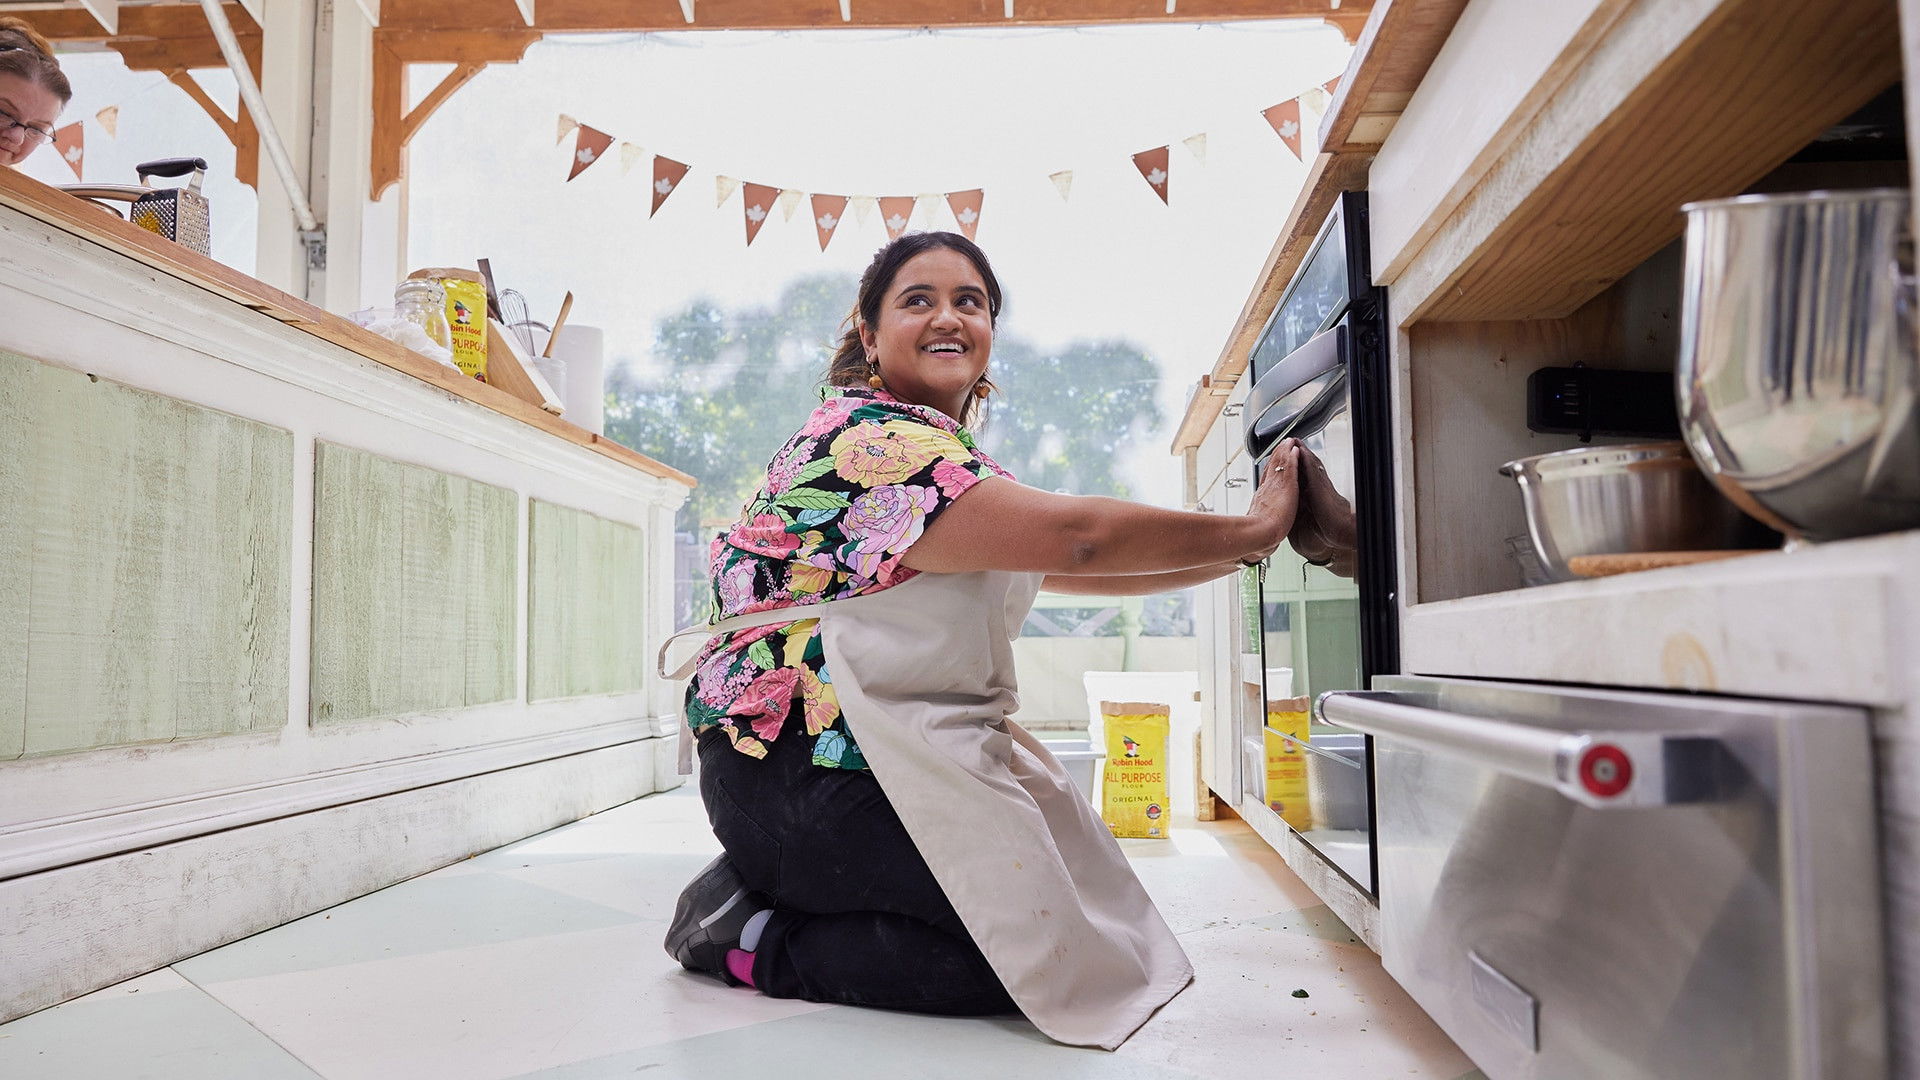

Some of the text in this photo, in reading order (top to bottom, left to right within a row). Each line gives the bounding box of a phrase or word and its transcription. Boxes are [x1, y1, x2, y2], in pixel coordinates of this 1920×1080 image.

[451, 324, 463, 332] bin
[465, 326, 481, 335] Hood
[1112, 759, 1133, 767] Robin
[1105, 772, 1161, 783] ALL PURPOSE
